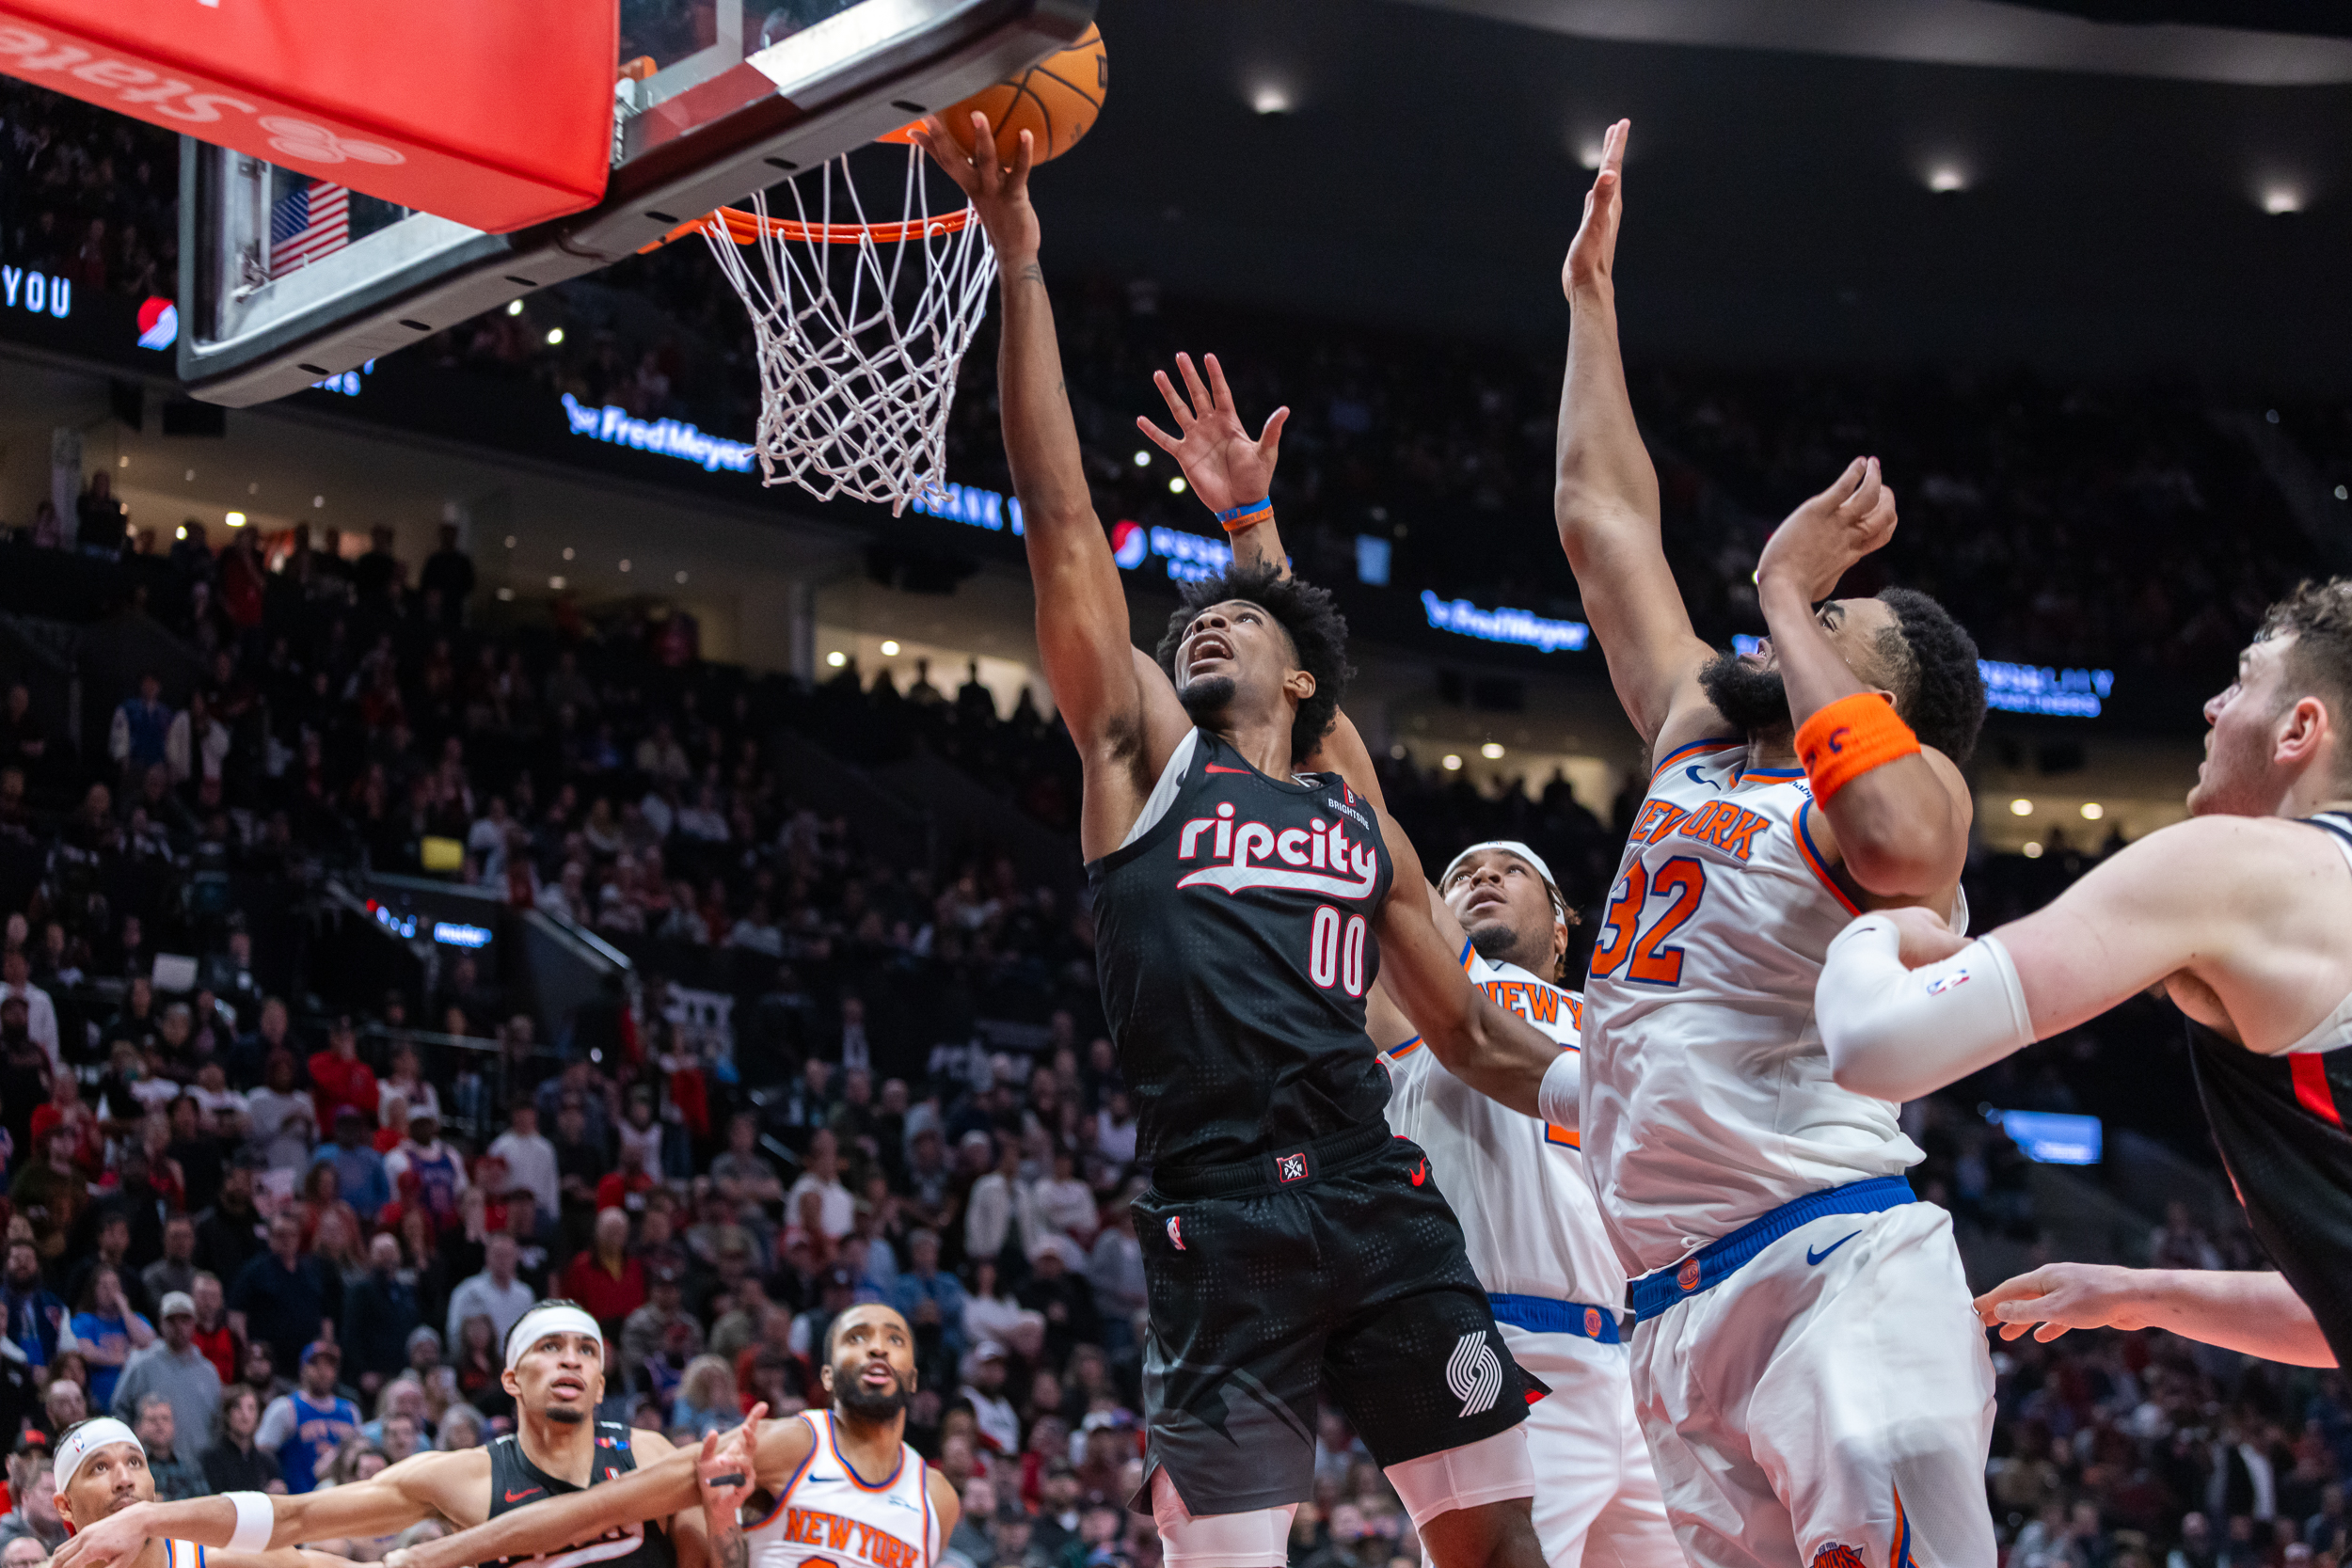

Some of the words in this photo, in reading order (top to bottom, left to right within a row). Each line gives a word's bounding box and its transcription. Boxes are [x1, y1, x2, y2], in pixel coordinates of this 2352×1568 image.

[0, 27, 257, 122] State
[2, 265, 71, 318] YOU
[1177, 801, 1377, 900] ripcity
[1328, 798, 1370, 831] BRIGHTSIDE
[1677, 800, 1773, 863] ORK
[1310, 905, 1367, 998] 00
[1589, 855, 1707, 987] 32
[785, 1507, 854, 1551] NEW
[858, 1521, 918, 1568] YORK
